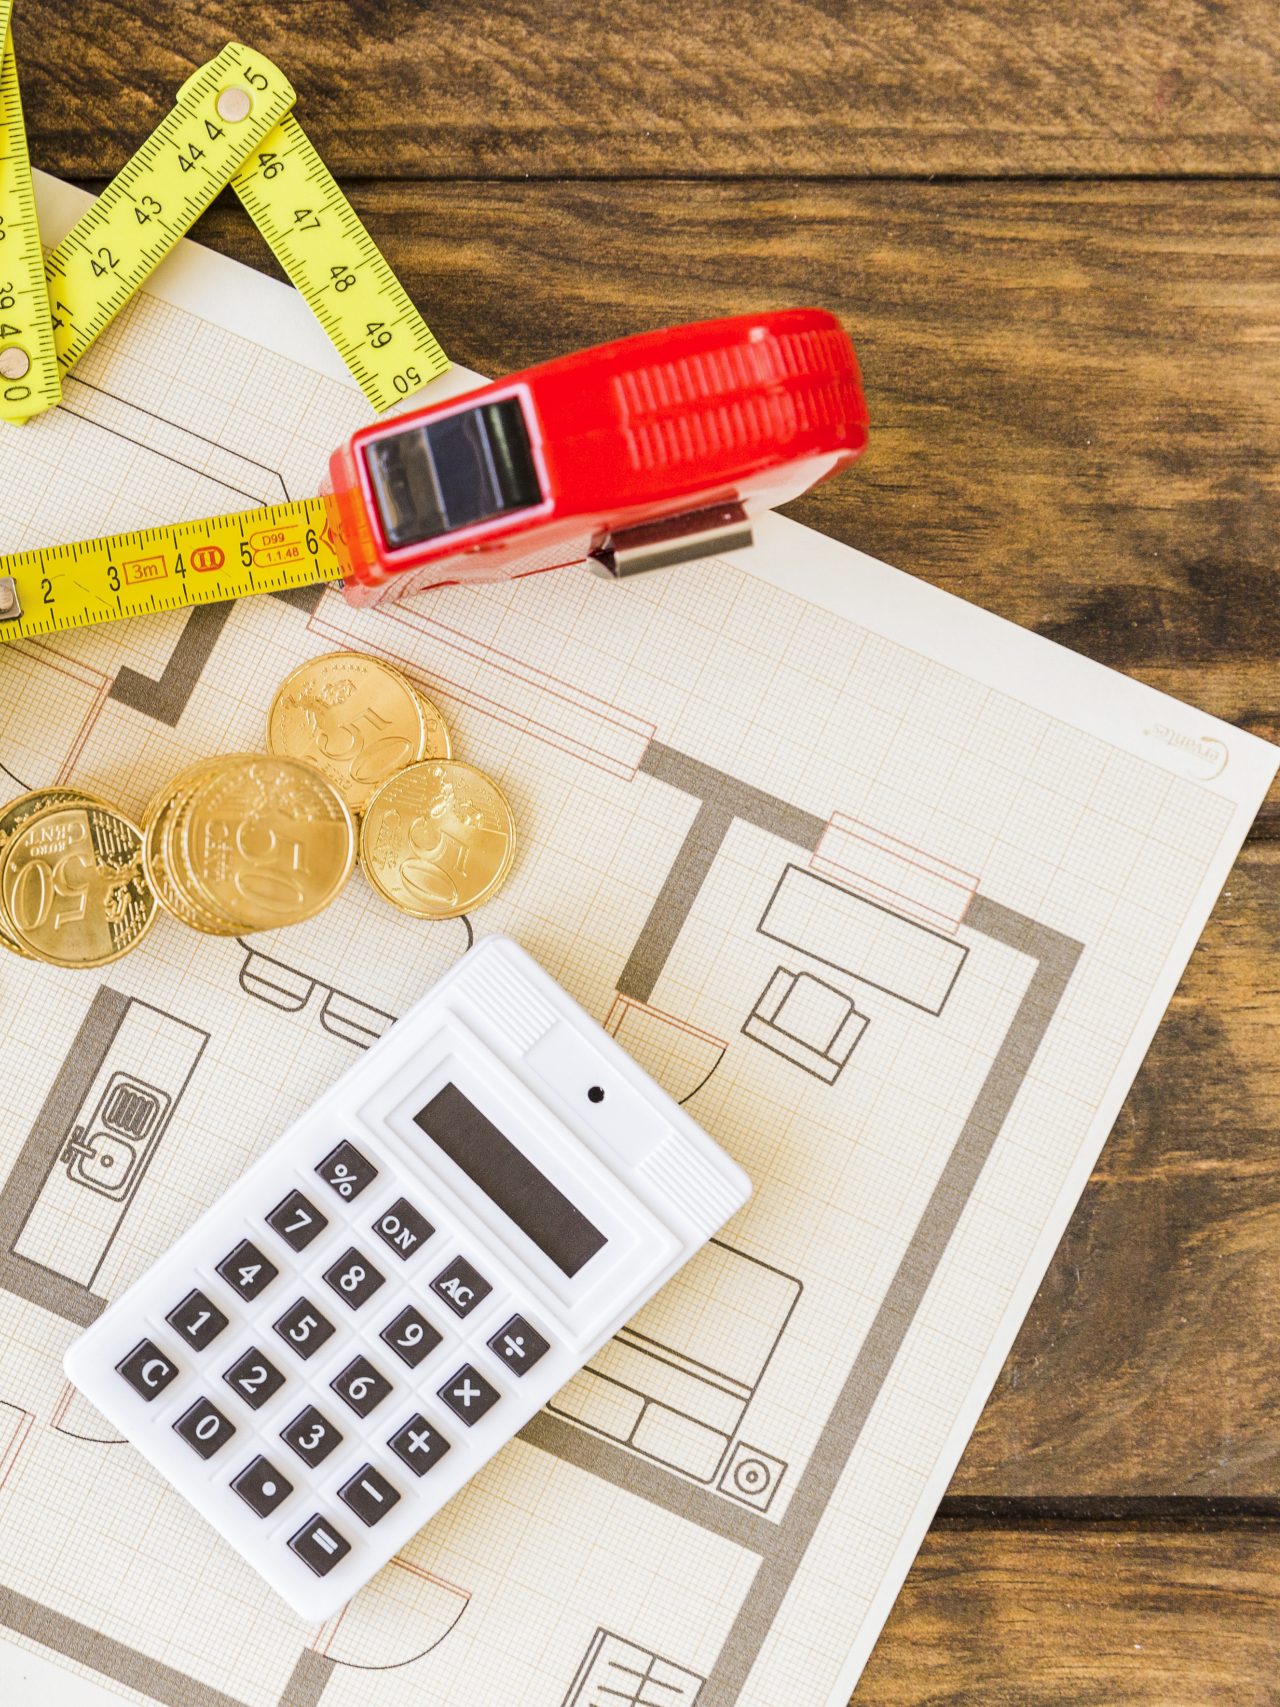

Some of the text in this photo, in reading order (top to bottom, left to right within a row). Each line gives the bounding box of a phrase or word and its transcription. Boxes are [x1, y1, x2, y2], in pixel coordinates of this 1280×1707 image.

[90, 247, 120, 278] 42
[134, 195, 162, 225] 43
[177, 143, 206, 173] 44
[257, 153, 422, 394] 46 47 48 49 50
[41, 528, 319, 605] 2 3 4 5 6
[132, 564, 158, 579] 3m
[262, 533, 285, 544] D99
[316, 707, 414, 784] 50
[25, 821, 86, 846] CENT
[235, 819, 309, 913] 50
[400, 814, 471, 906] 50
[11, 854, 89, 931] 50
[284, 1208, 313, 1233] 7
[339, 1265, 366, 1292] 8
[397, 1323, 424, 1347] 9
[330, 1163, 358, 1196] %
[382, 1215, 417, 1250] ON
[439, 1277, 474, 1307] AC
[238, 1264, 262, 1286] 4
[289, 1315, 318, 1342] 5
[348, 1376, 376, 1400] 6
[141, 1359, 170, 1387] C
[195, 1414, 220, 1440] 0
[186, 1311, 211, 1336] 1
[238, 1365, 268, 1394] 2
[298, 1424, 326, 1450] 3
